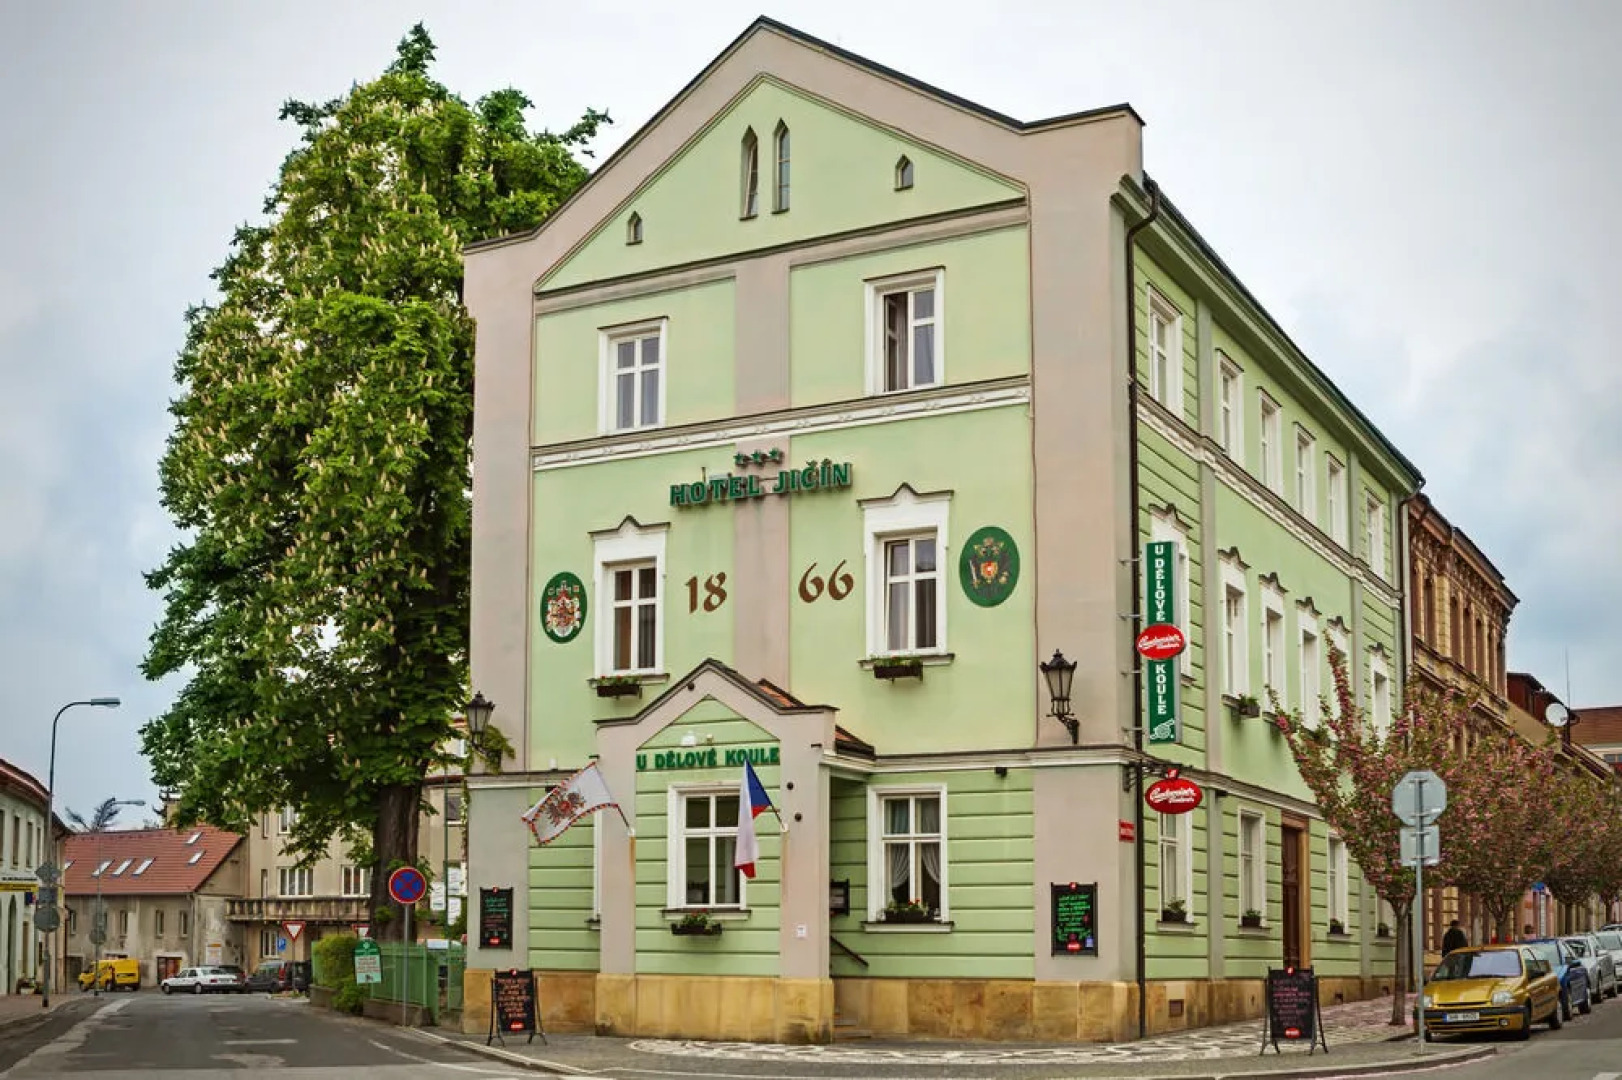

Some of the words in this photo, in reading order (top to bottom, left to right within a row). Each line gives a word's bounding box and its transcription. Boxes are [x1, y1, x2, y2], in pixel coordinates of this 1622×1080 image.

[670, 475, 761, 507] HOTEL
[773, 459, 853, 494] JIČÍN
[1154, 544, 1164, 556] U
[684, 571, 728, 614] 18
[798, 559, 854, 604] 66
[1155, 664, 1167, 715] KOULE
[636, 753, 647, 770] U
[654, 748, 718, 769] DĚLOVÉ
[725, 747, 780, 766] KOULE
